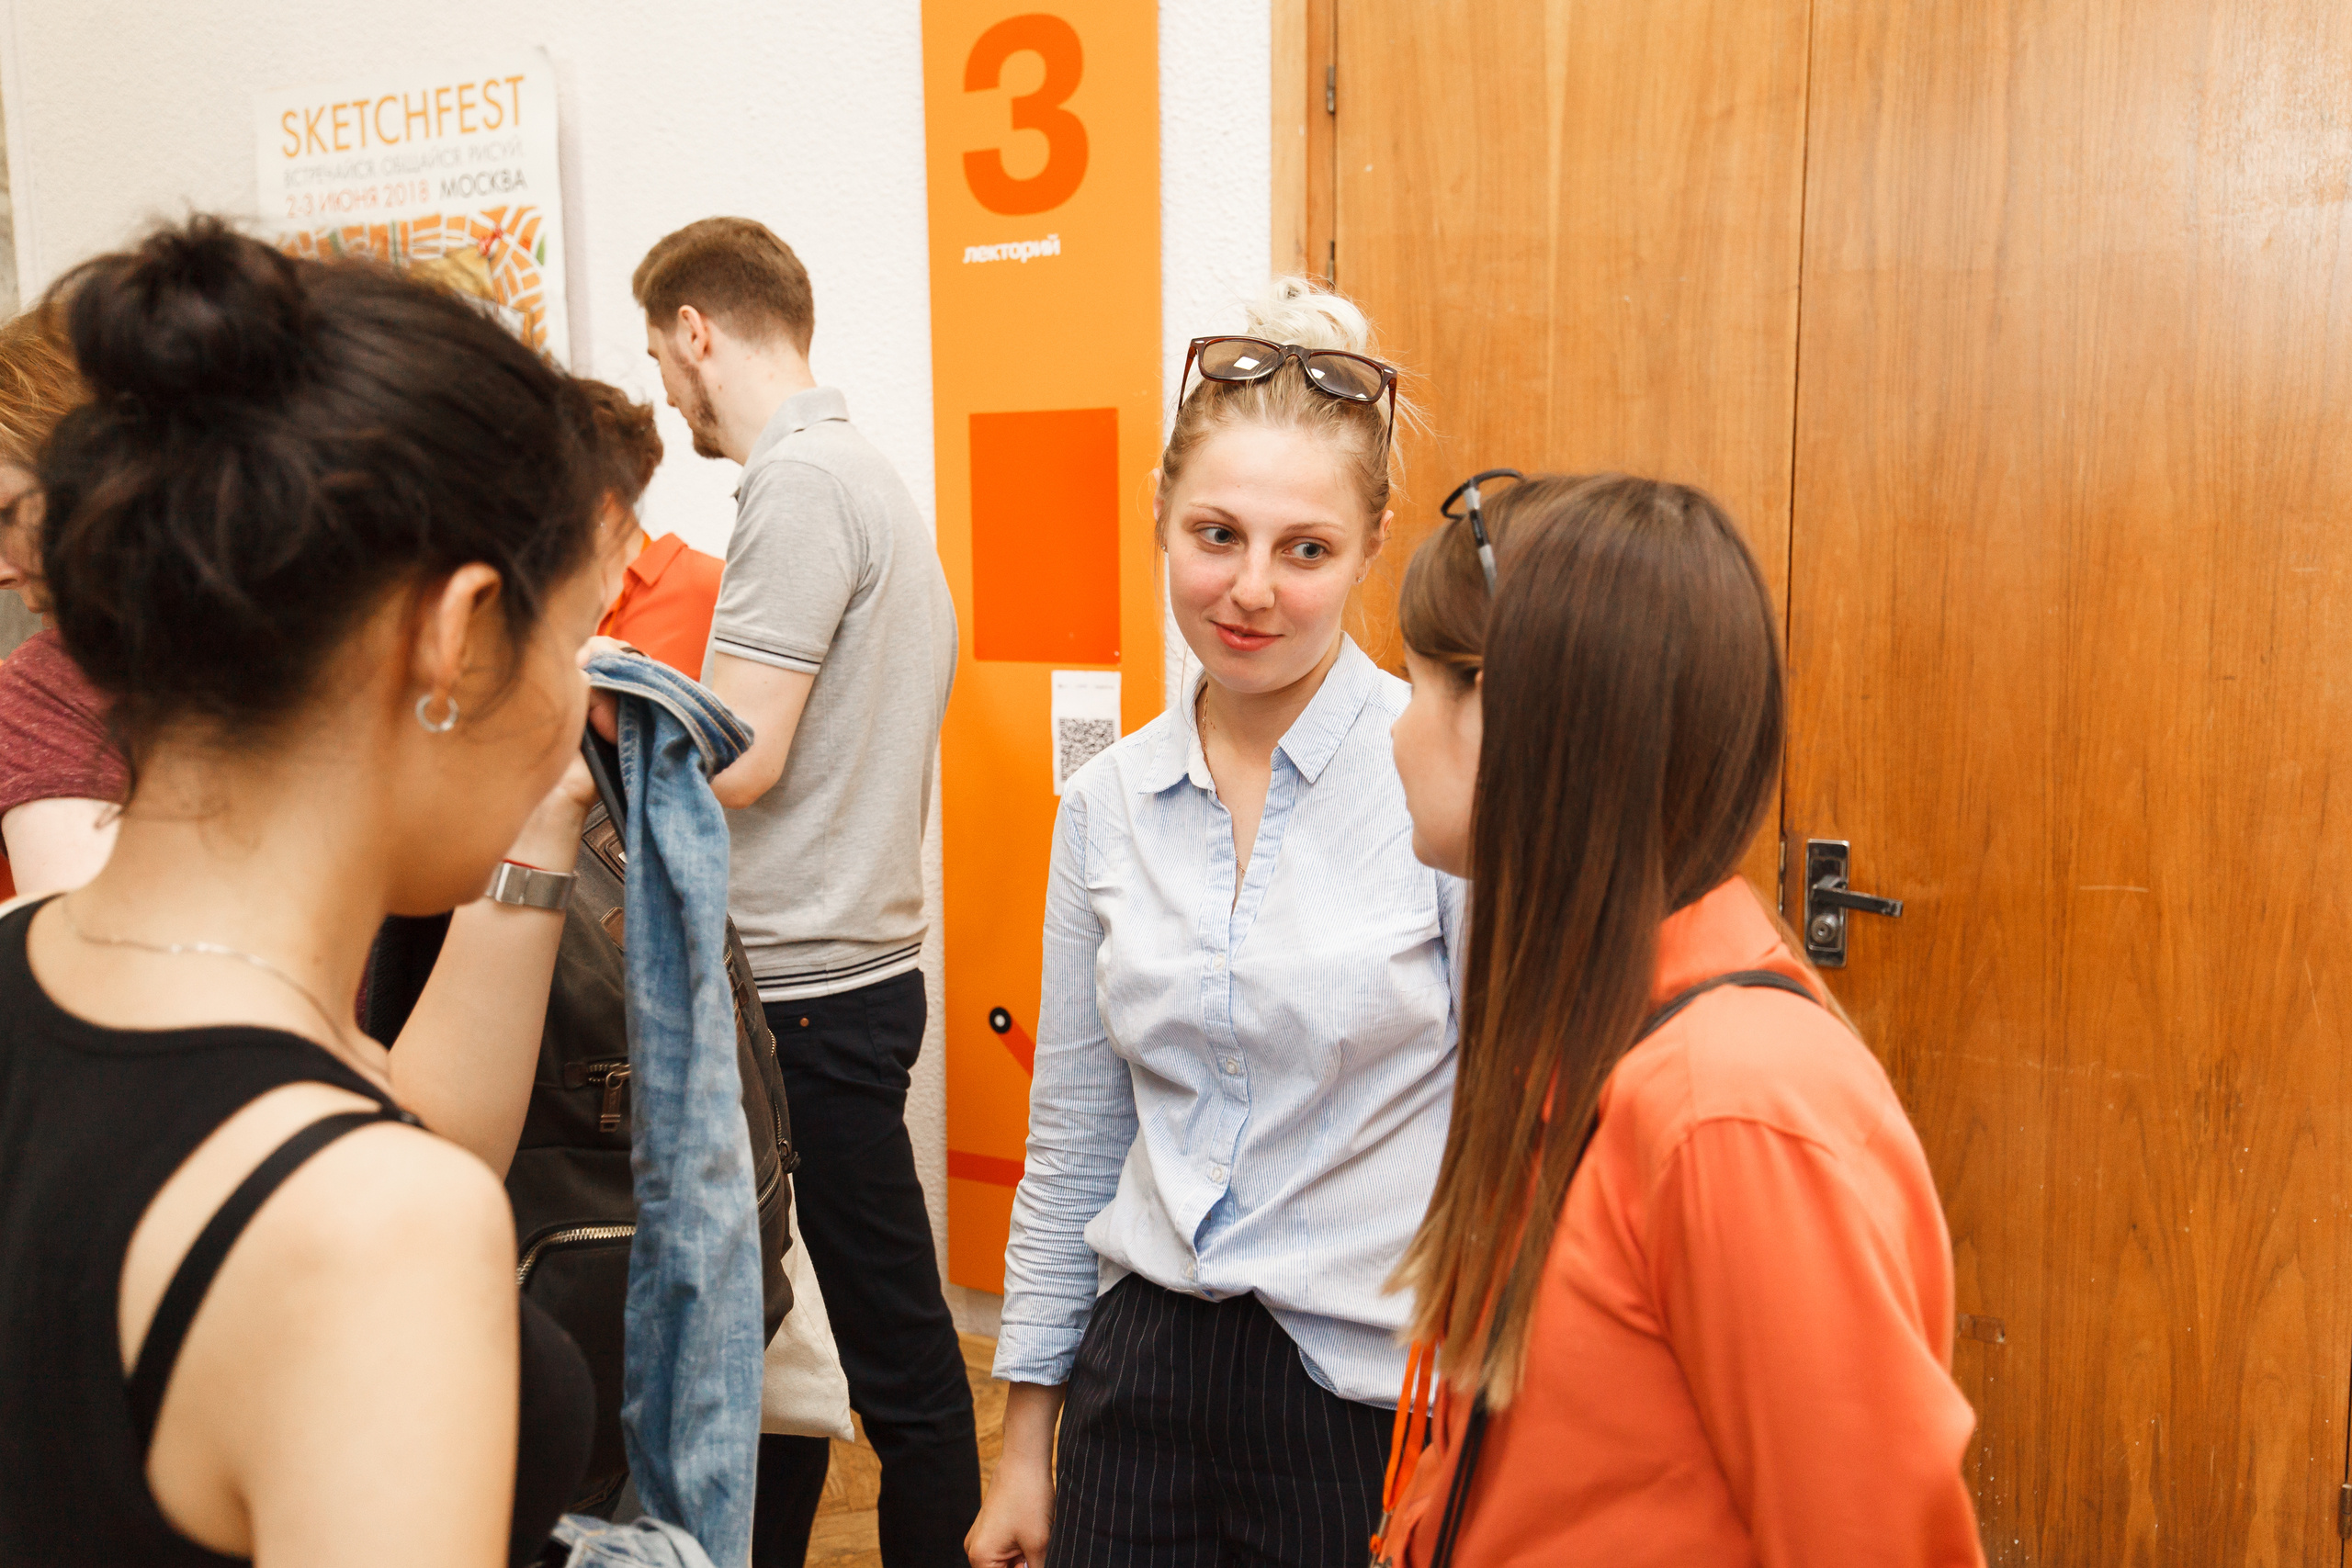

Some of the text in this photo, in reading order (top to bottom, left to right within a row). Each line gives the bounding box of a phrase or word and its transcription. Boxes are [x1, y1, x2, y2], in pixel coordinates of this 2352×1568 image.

[282, 73, 525, 158] SKETCHFEST
[963, 12, 1090, 218] 3
[383, 178, 430, 208] 2018
[439, 169, 528, 199] МОСКВА
[963, 233, 1061, 264] лекторий
